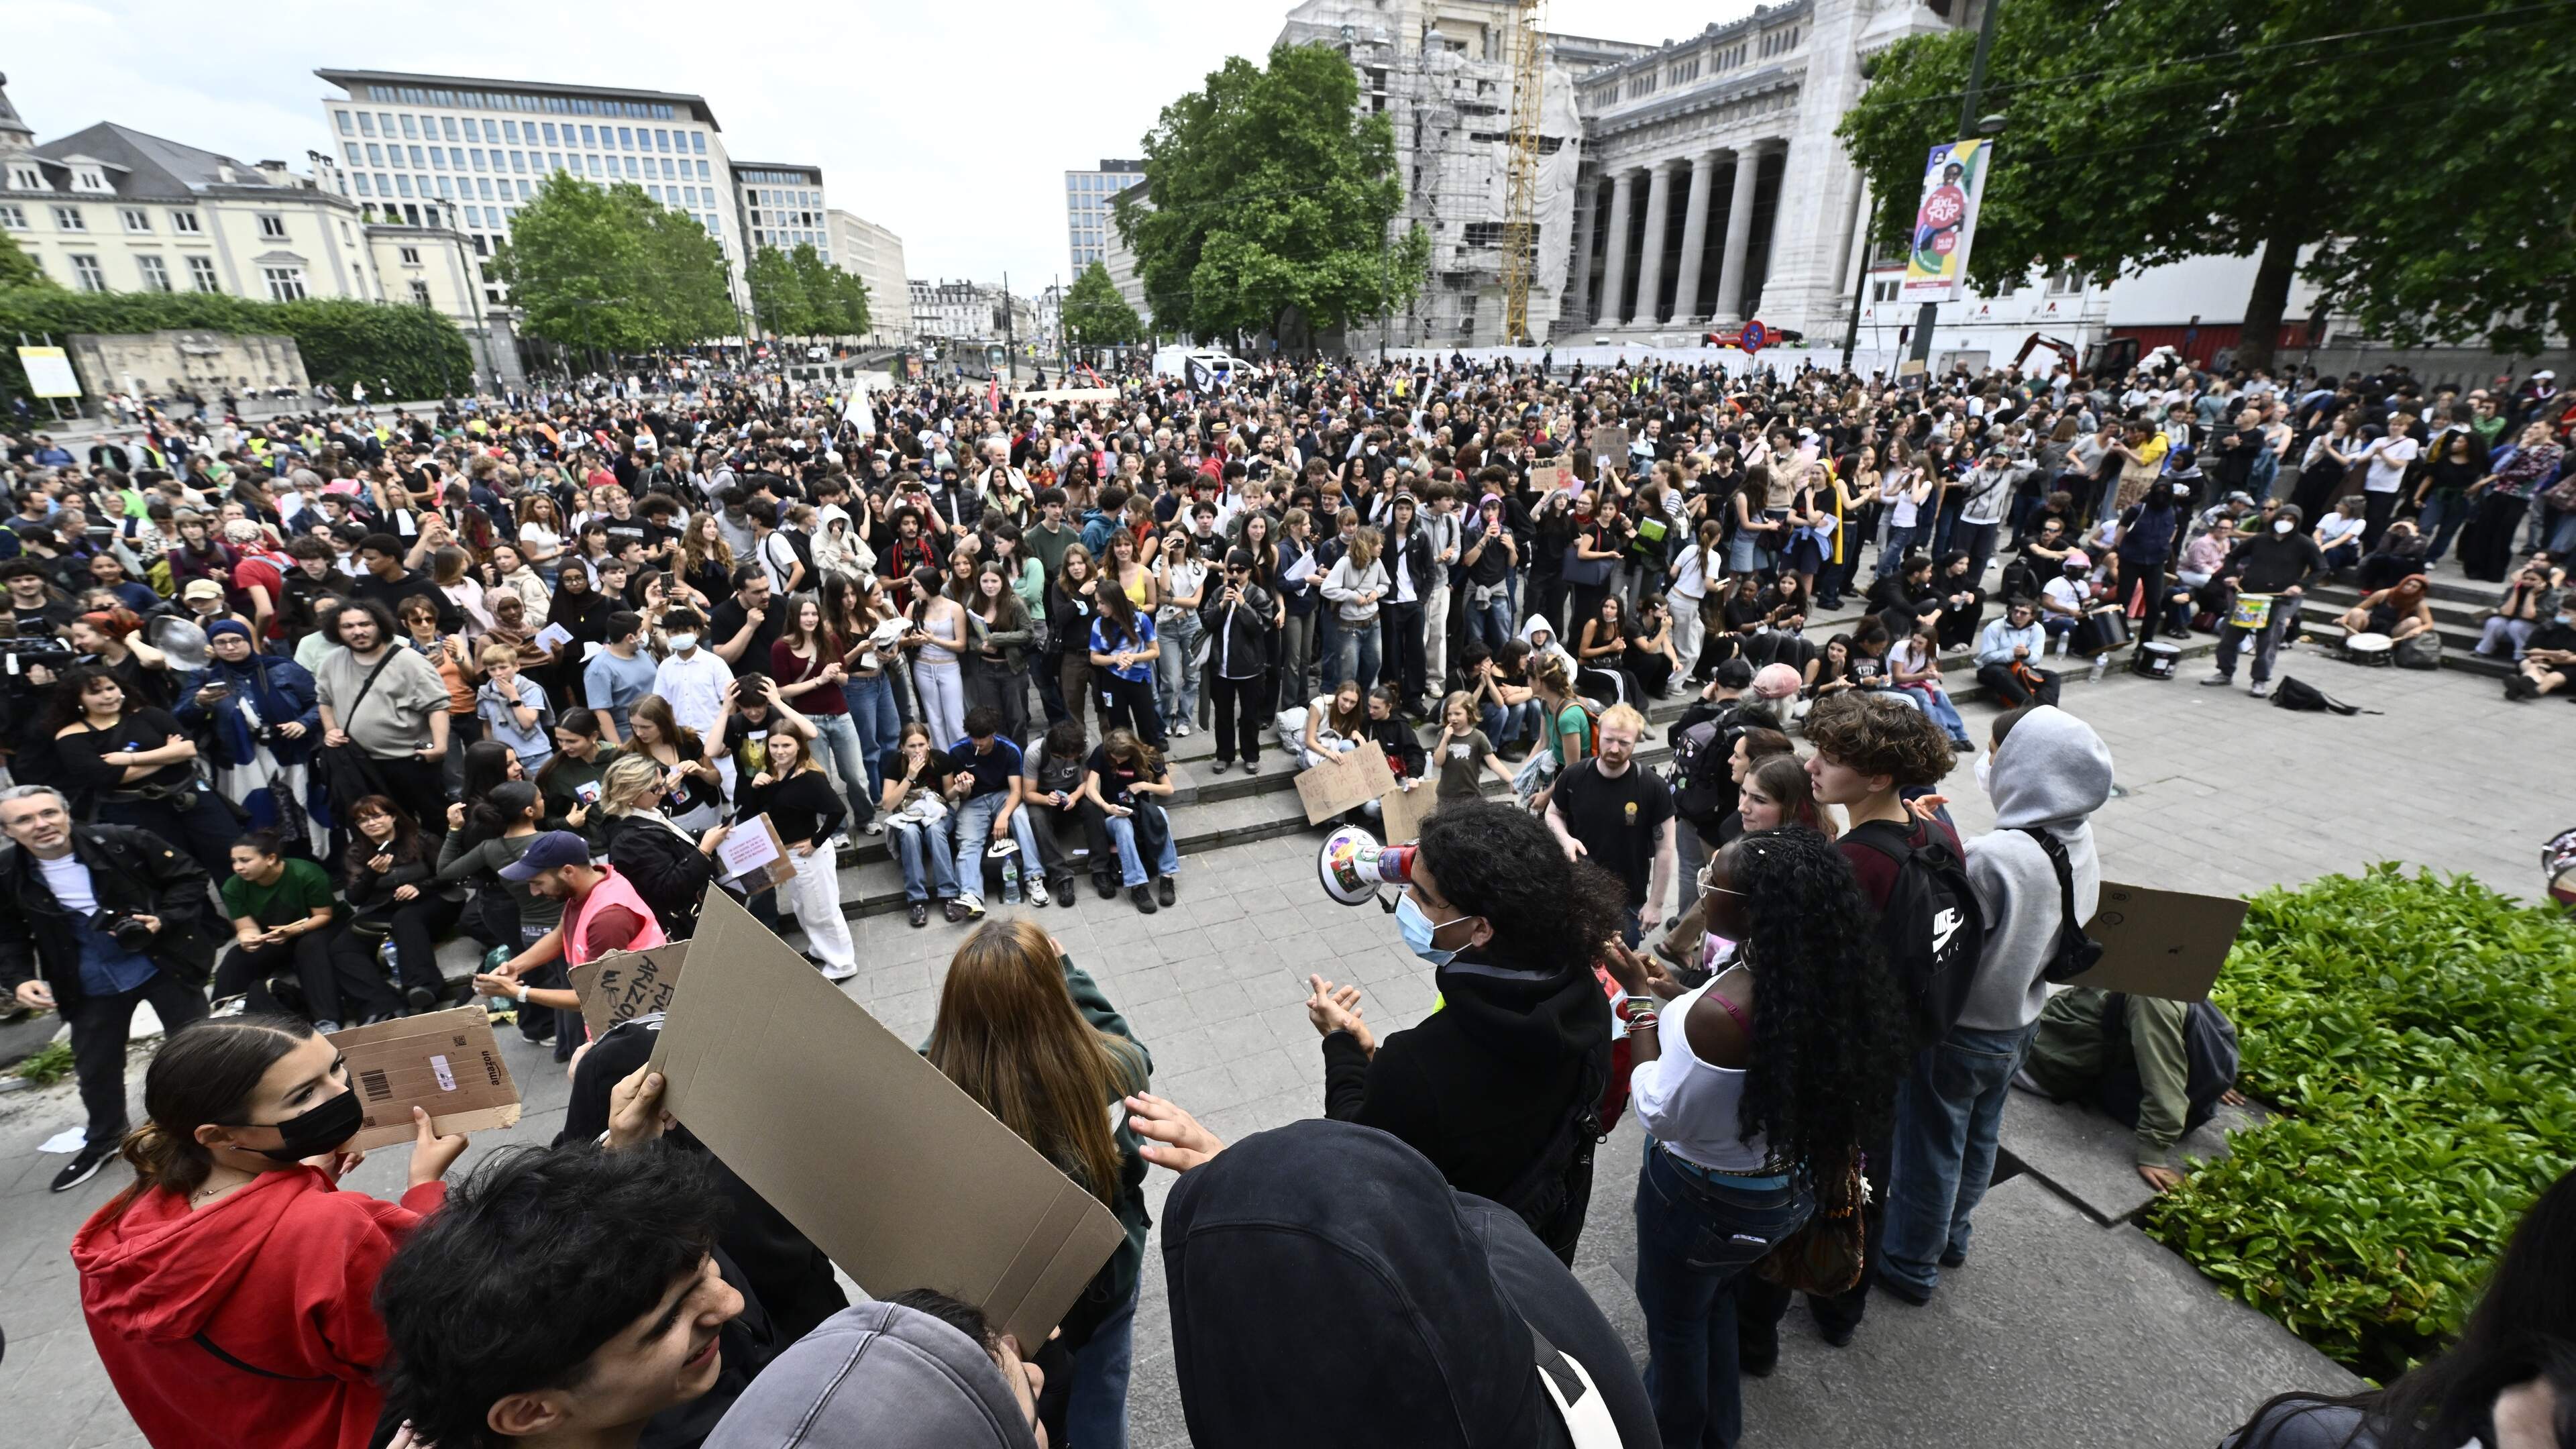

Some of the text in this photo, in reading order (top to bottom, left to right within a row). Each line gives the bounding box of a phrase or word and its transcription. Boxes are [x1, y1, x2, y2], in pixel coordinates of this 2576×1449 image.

[1927, 203, 1960, 223] TOUR
[1932, 197, 1953, 209] BXL
[481, 1051, 500, 1085] amazon
